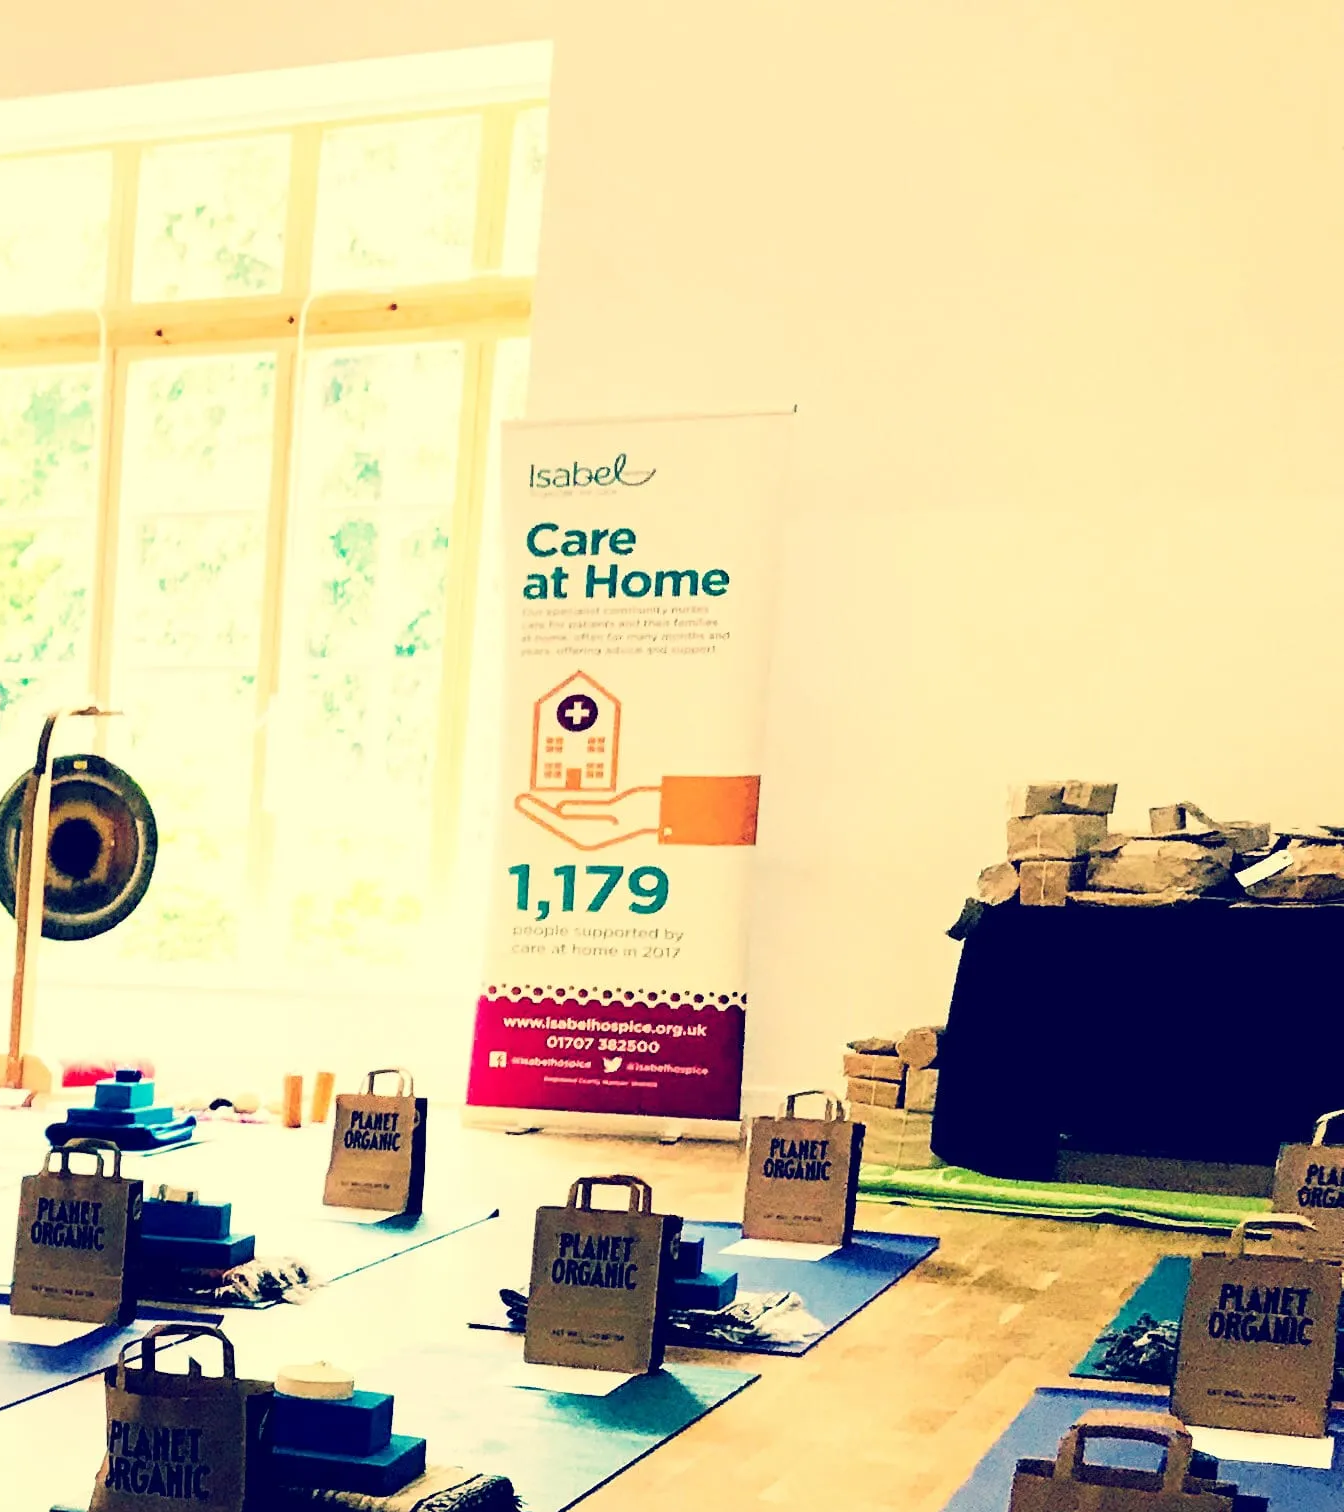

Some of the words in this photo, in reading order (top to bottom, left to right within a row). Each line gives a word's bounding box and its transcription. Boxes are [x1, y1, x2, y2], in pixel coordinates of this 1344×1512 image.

[529, 453, 656, 489] Isabel
[526, 522, 637, 558] Care
[522, 566, 570, 600] at
[585, 563, 730, 600] Home
[709, 630, 731, 642] and
[508, 864, 669, 921] 1,179
[512, 925, 569, 939] people
[574, 926, 660, 940] supported
[664, 928, 684, 942] by
[511, 943, 547, 954] care
[551, 943, 567, 954] at
[572, 943, 619, 956] home
[623, 946, 637, 957] in
[642, 946, 682, 959] 2017
[503, 1016, 708, 1038] www.isabelhospice.org.uk
[546, 1036, 594, 1050] 01707
[598, 1038, 661, 1054] 382500
[351, 1111, 400, 1131] PLANET
[344, 1130, 401, 1151] ORGANIC
[770, 1138, 829, 1160] PLANET
[763, 1158, 832, 1181] ORGANIC
[37, 1197, 102, 1226] PLANET
[31, 1221, 105, 1251] ORGANIC
[559, 1232, 637, 1262] PLANET
[552, 1258, 638, 1290] ORGANIC
[1218, 1283, 1312, 1316] PLANET
[1209, 1311, 1313, 1347] ORGANIC
[109, 1419, 203, 1463] PLANET
